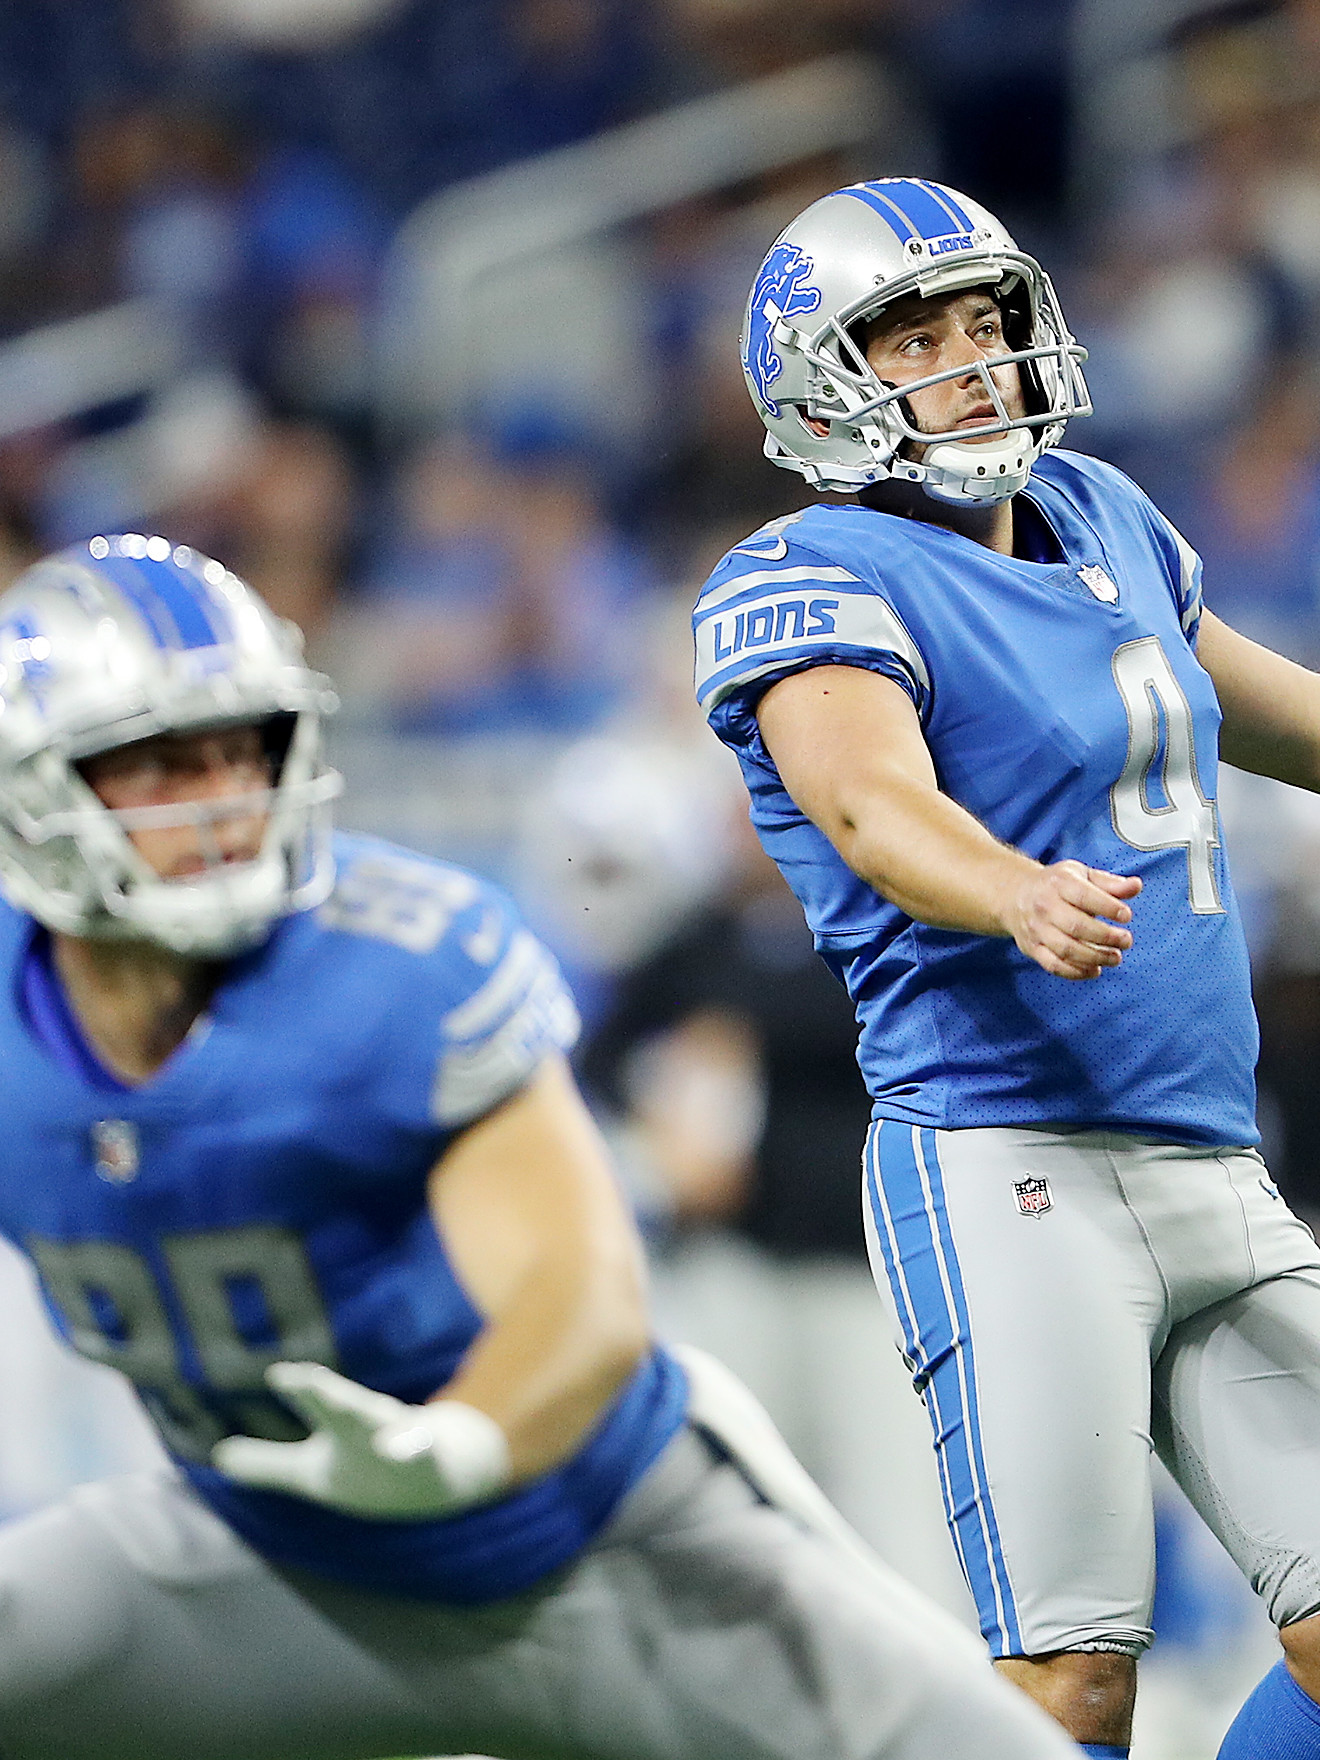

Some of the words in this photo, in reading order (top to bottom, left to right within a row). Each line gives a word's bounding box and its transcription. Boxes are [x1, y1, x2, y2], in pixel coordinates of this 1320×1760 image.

[928, 235, 974, 256] LIONS
[713, 599, 840, 663] LIONS
[1109, 634, 1227, 914] 4
